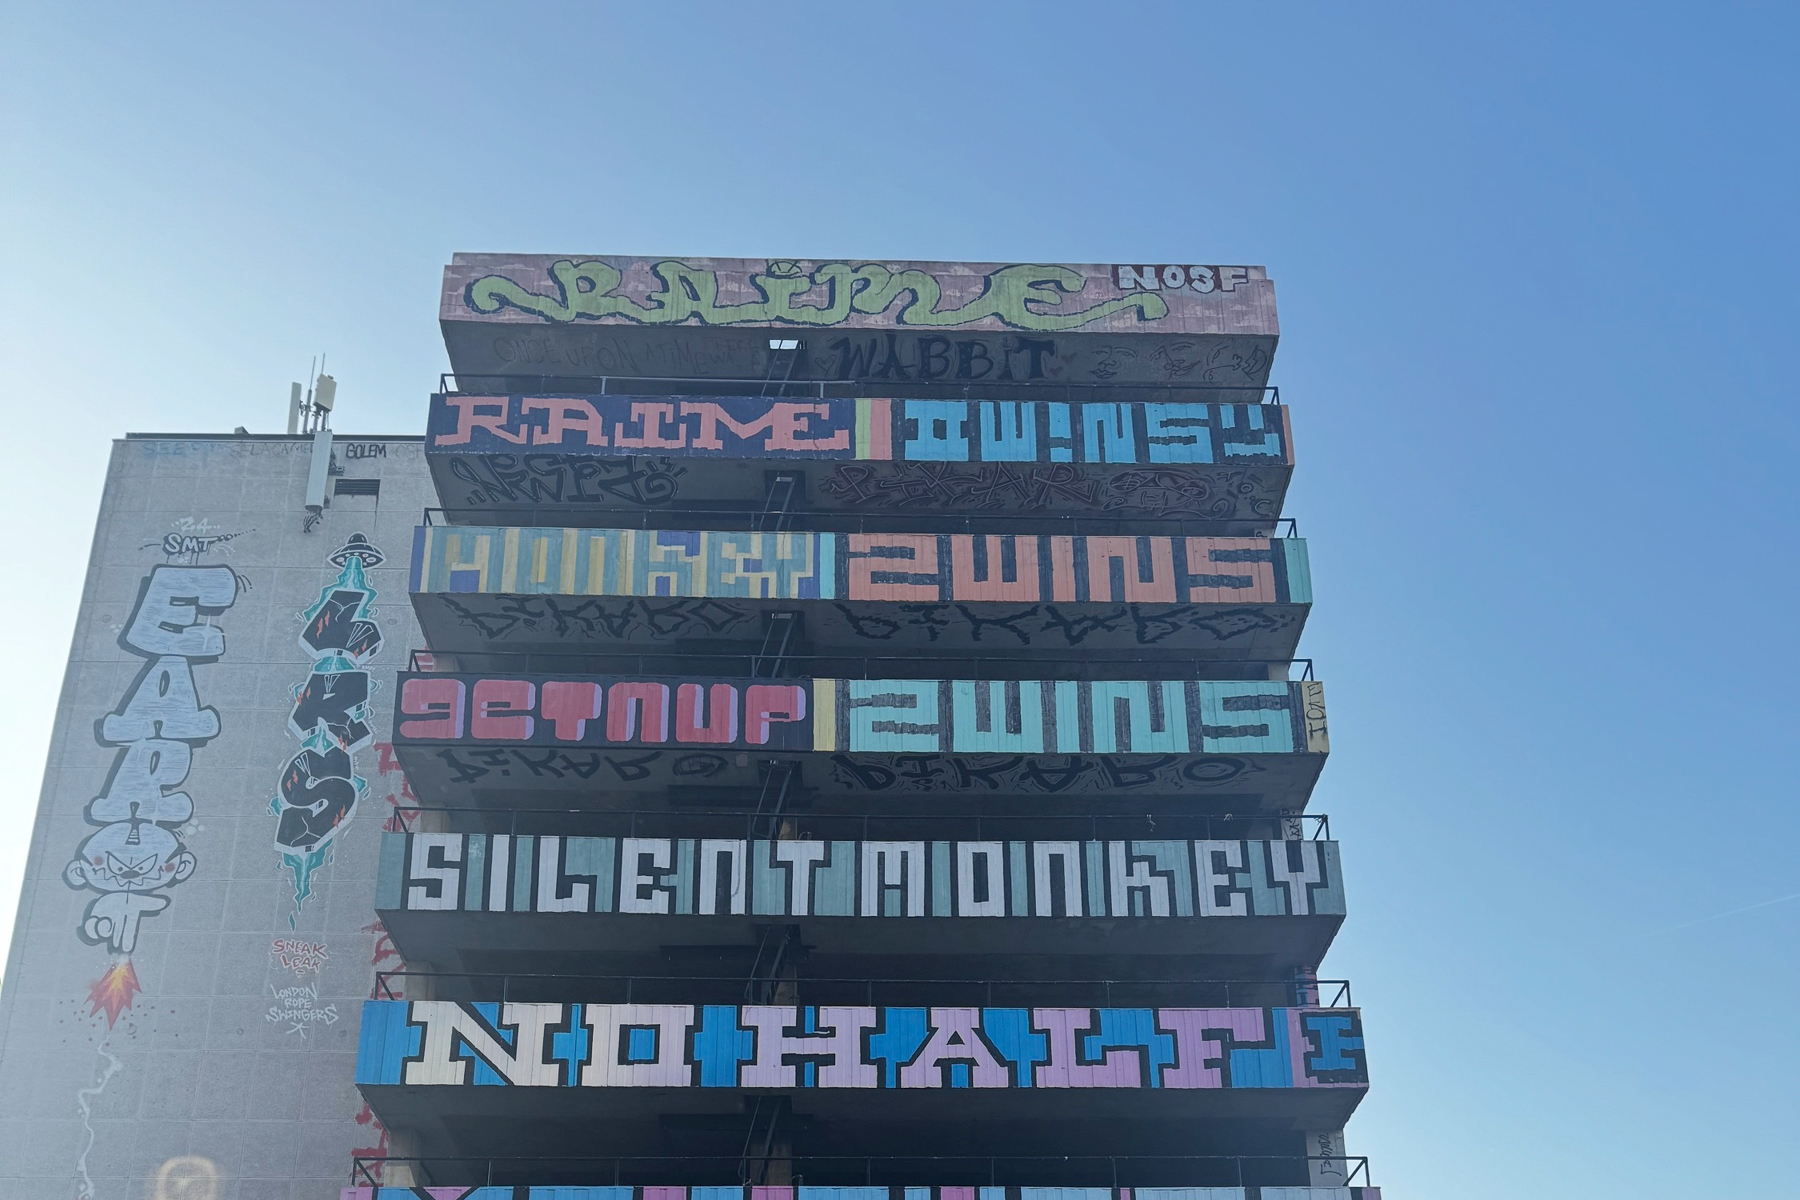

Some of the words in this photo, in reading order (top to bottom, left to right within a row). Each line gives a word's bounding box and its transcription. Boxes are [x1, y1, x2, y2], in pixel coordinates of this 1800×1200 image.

[408, 833, 824, 917] SILENT
[861, 840, 1321, 917] MONKEY
[270, 982, 318, 1002] LONDON
[284, 998, 313, 1009] ROPE
[265, 1004, 339, 1026] SWINGERS
[405, 1000, 695, 1088] NO
[741, 1005, 1266, 1089] HALF
